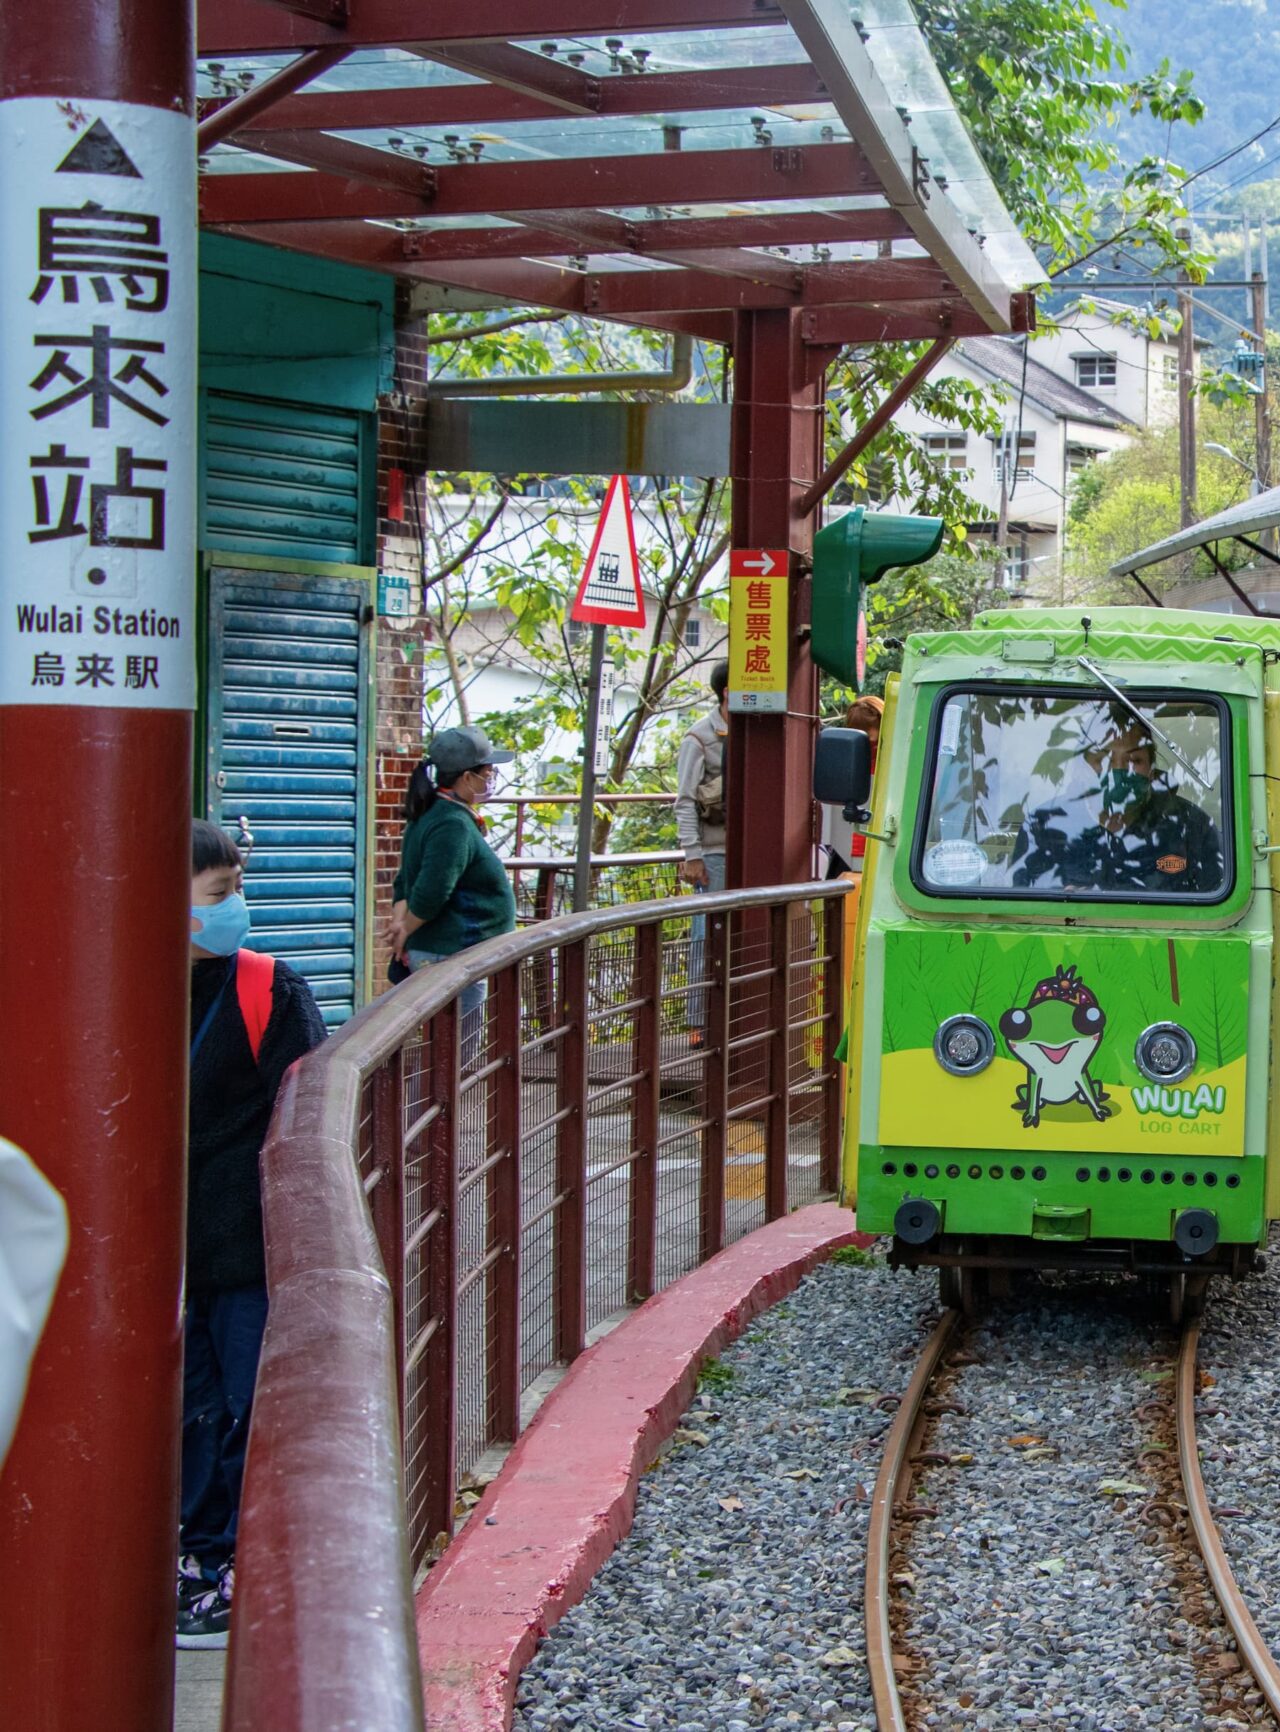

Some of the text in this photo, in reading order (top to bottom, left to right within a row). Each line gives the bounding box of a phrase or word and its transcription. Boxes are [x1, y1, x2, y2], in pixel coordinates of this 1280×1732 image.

[28, 199, 170, 551] 烏來站
[17, 604, 180, 638] Wulai Station
[745, 580, 772, 673] 售票處
[31, 651, 159, 689] 烏来駅
[1131, 1083, 1226, 1119] WULAI
[1139, 1120, 1222, 1136] LOG CART
